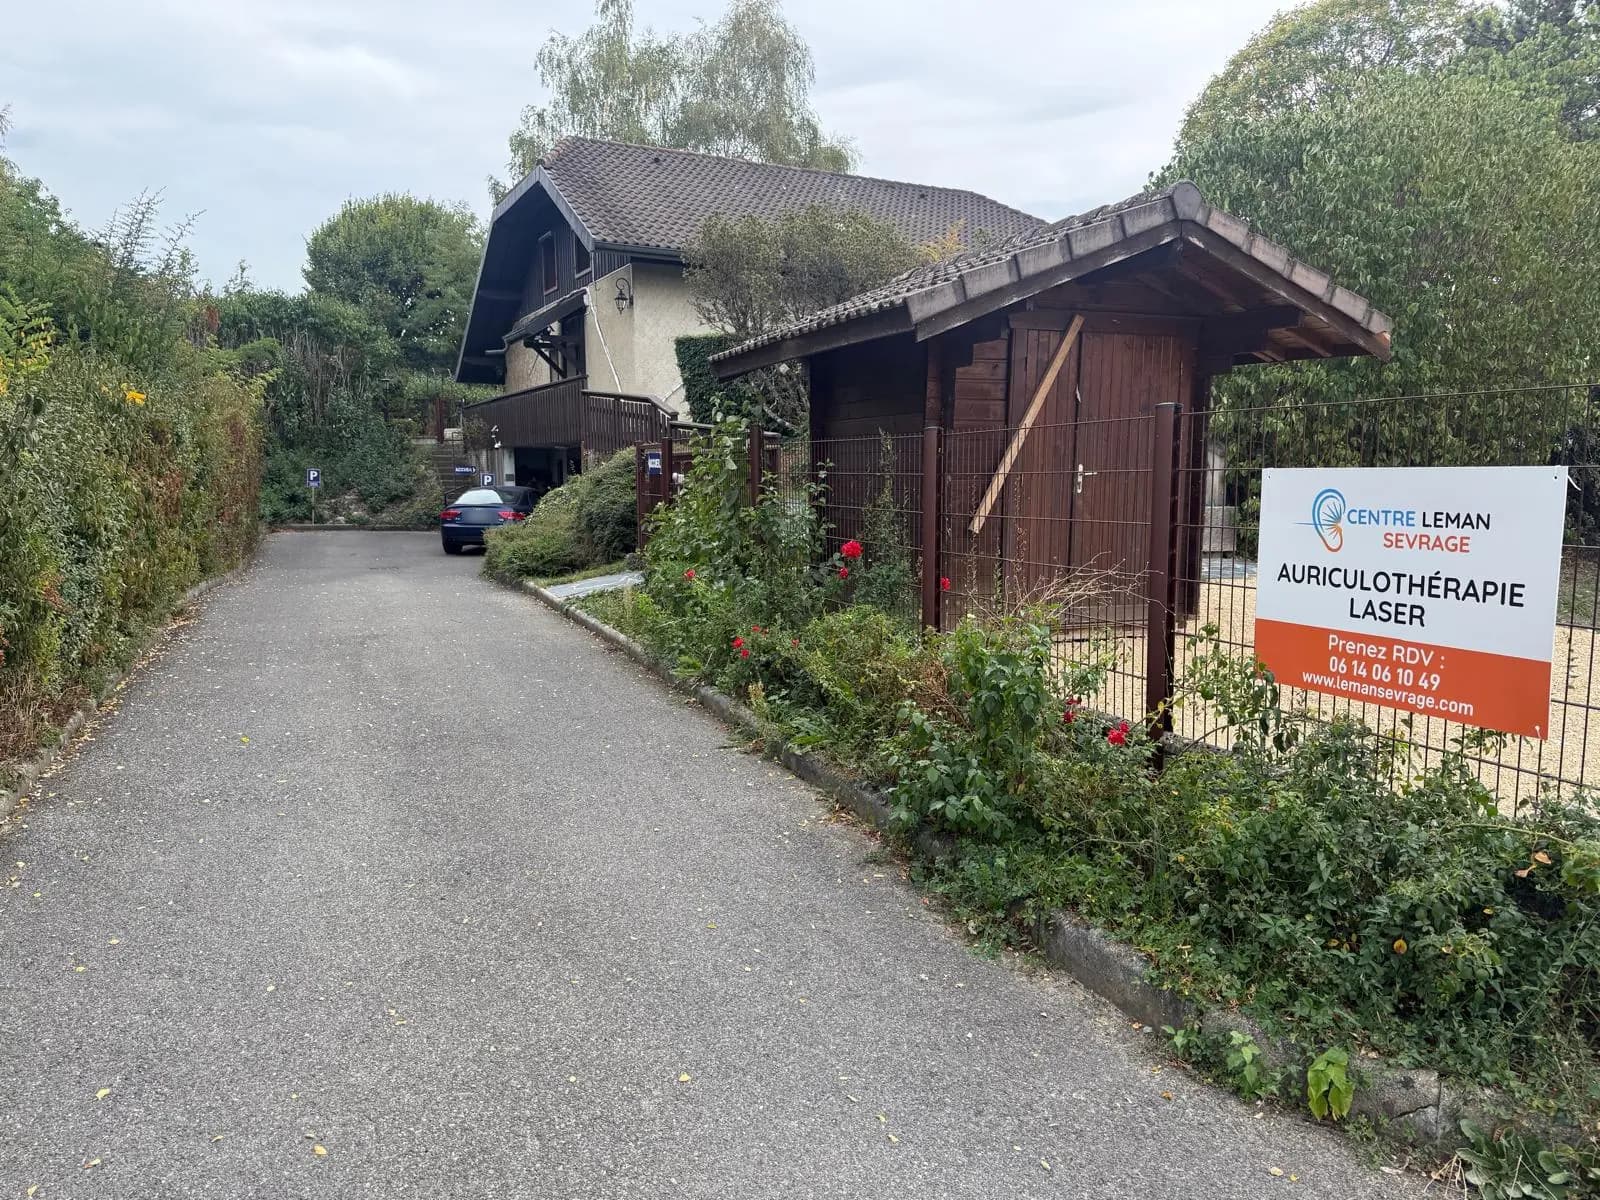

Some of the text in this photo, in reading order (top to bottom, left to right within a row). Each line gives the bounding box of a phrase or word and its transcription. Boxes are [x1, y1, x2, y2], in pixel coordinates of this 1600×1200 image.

[309, 470, 318, 481] P
[483, 475, 492, 485] P
[1347, 508, 1491, 531] CENTRE LEMAN
[1383, 532, 1471, 554] SEVRAGE
[1277, 562, 1526, 608] AURICULOTHÉRAPIE
[1349, 597, 1426, 628] LASER
[1328, 633, 1387, 660] Prenez
[1392, 644, 1435, 666] RDV
[1329, 655, 1441, 691] 06 14 06 10 49
[1302, 670, 1474, 717] www.lemansevrage.com
